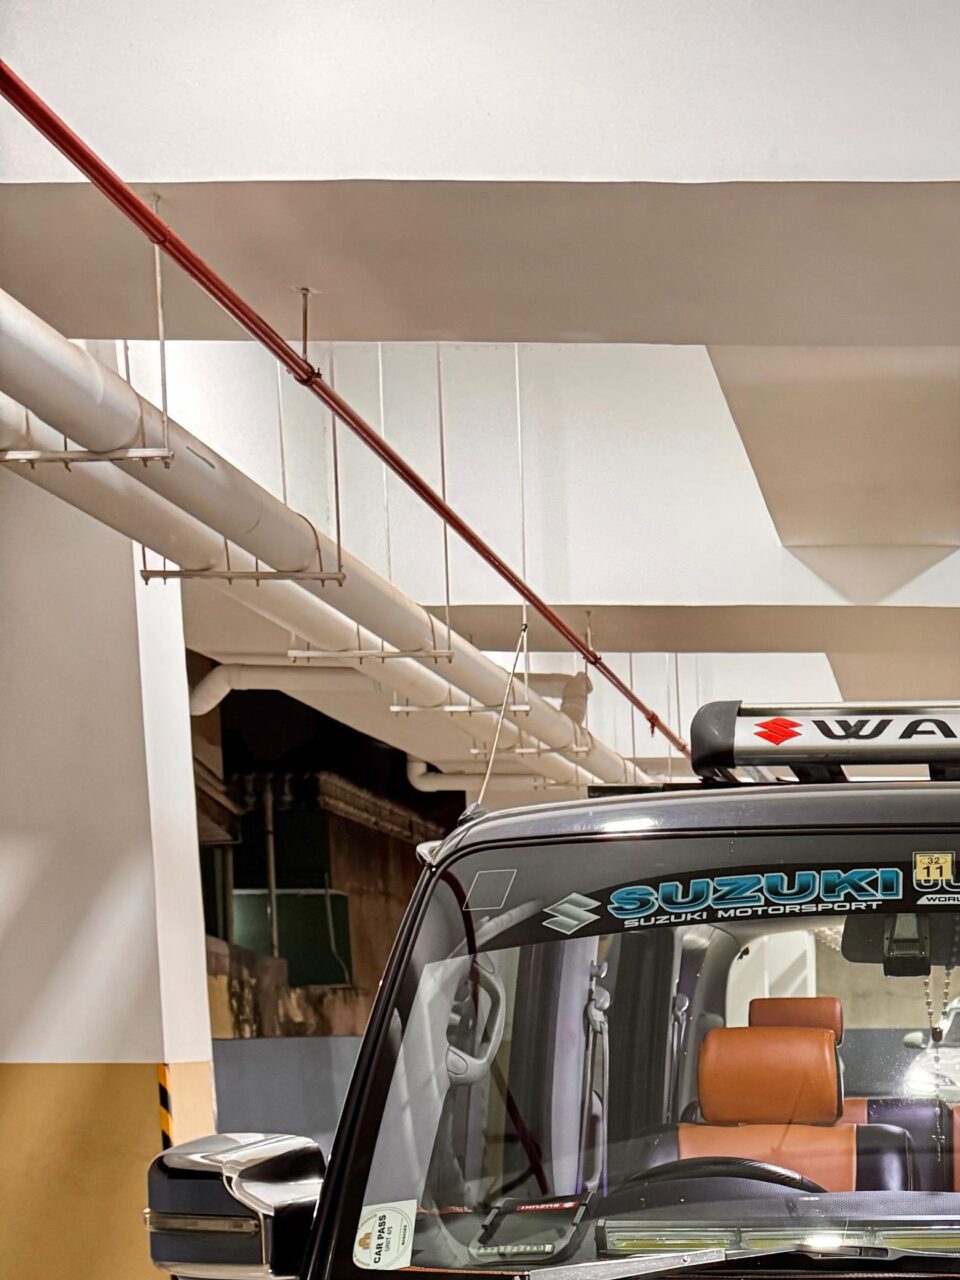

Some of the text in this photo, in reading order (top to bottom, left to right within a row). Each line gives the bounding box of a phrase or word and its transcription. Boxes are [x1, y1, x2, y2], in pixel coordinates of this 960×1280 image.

[922, 865, 944, 878] 11
[927, 857, 940, 865] 32
[607, 867, 904, 919] SUZUKI
[623, 901, 883, 929] SUZUKI MOTORSPORT
[373, 1214, 387, 1264] CAR PASS
